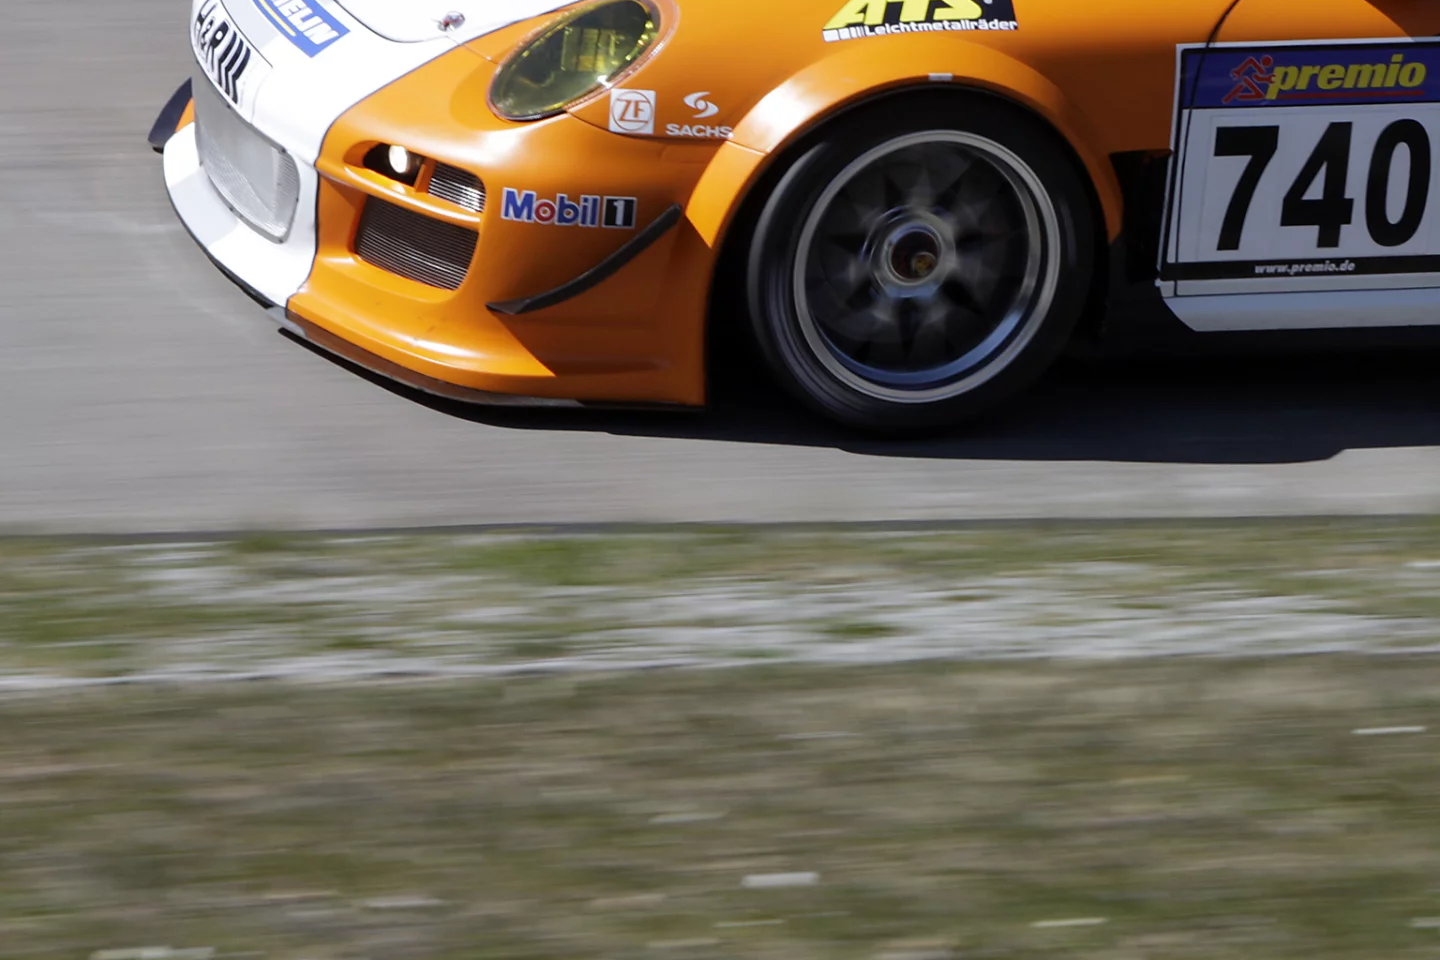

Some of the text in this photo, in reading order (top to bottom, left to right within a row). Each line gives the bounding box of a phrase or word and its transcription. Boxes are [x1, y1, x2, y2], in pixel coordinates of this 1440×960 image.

[864, 18, 1018, 37] Leichtmetallräder
[1266, 53, 1427, 101] premio
[665, 123, 734, 138] SACHS
[1214, 118, 1432, 252] 740
[501, 187, 600, 227] Mobil
[1254, 259, 1356, 275] www.premio.de
